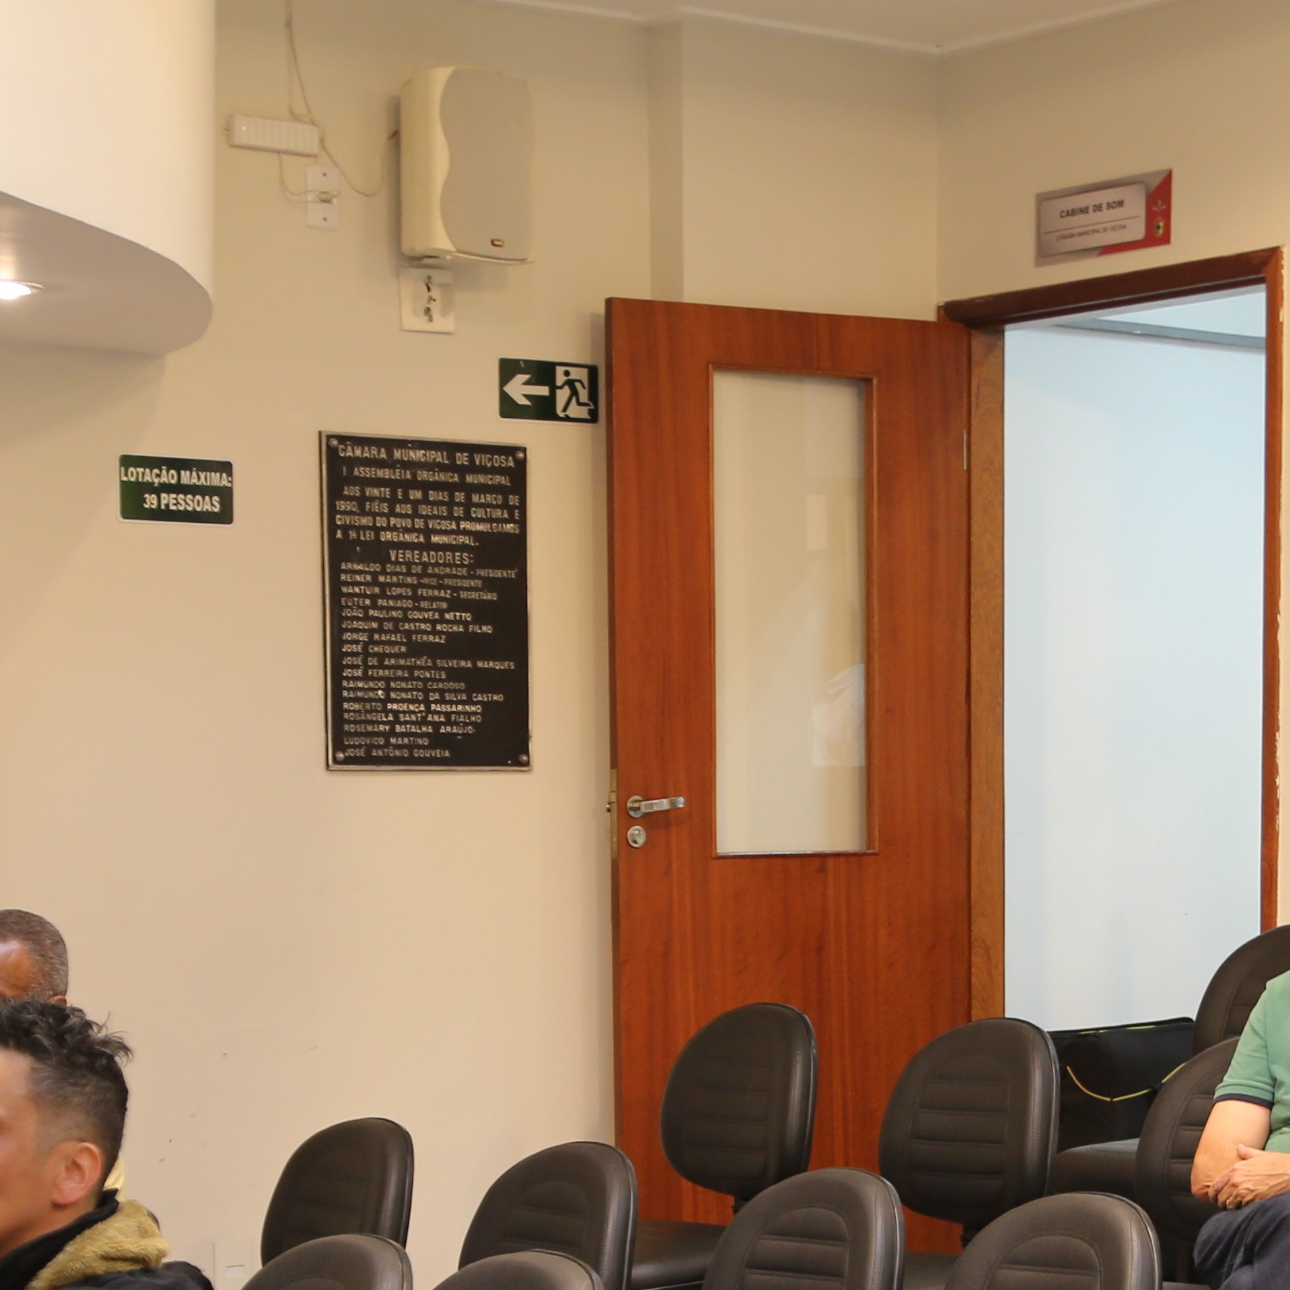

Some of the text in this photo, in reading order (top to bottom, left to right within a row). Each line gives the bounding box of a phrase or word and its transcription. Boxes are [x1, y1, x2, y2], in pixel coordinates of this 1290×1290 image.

[1060, 200, 1124, 218] CABINE DE SOM
[338, 442, 514, 468] CÂMARA MUNICIPAL DE VIÇOSA
[121, 466, 232, 487] LOTAÇÃO MÁXIMA:
[353, 465, 411, 479] ASSEMBLÉIA
[417, 468, 459, 482] ORGÂNICA
[466, 474, 511, 485] MUNICIPAL
[343, 486, 519, 505] AOS VINTE E UM DIAS DE MARÇO DE
[143, 493, 221, 512] 39 PESSOAS
[395, 504, 412, 514] AOS
[418, 505, 447, 516] IDEAIS
[454, 507, 464, 517] DE
[471, 508, 508, 518] CULTURA
[515, 509, 519, 519] E
[336, 515, 372, 526] CIVISMO
[376, 517, 387, 526] DO
[390, 518, 411, 528] POVO
[414, 519, 424, 528] DE
[460, 521, 519, 533] PROMULGAMOS
[336, 530, 343, 539] A
[360, 530, 374, 540] LEI
[380, 529, 424, 542] ORGÂNICA
[390, 550, 473, 564] VEREADORES:
[341, 562, 381, 571] ARNALDO
[386, 564, 406, 572] DIAS
[412, 565, 422, 573] DE
[427, 567, 467, 575] ANDRADE
[378, 575, 417, 584] MARTINS
[386, 587, 412, 596] LOPES
[418, 589, 451, 598] FERRAZ
[341, 606, 363, 617] JOÃO
[369, 610, 403, 618] PAULINO
[444, 612, 472, 621] NETTO
[341, 621, 379, 629] JOAQUIM
[383, 622, 393, 630] DE
[399, 622, 432, 631] CASTRO
[436, 624, 464, 632] ROCHA
[342, 632, 445, 643] JORGE RAFAEL FERRAZ
[342, 642, 406, 653] JOSÉ CHEQUER
[342, 655, 363, 665] JOSÉ
[436, 660, 472, 668] SILVEIRA
[477, 661, 515, 669] MARQUES
[342, 666, 446, 679] JOSÉ FERREIRA PONTES
[342, 680, 385, 688] RAIMUNDO
[429, 692, 440, 700] DA
[472, 693, 504, 701] CASTRO
[343, 702, 382, 710] ROBERTO
[431, 704, 482, 712] PASSARINHO
[451, 714, 482, 722] FIALHO
[344, 724, 390, 732] ROSEMARY
[395, 725, 433, 733] BATALHA
[344, 737, 384, 745] LUDOVICO
